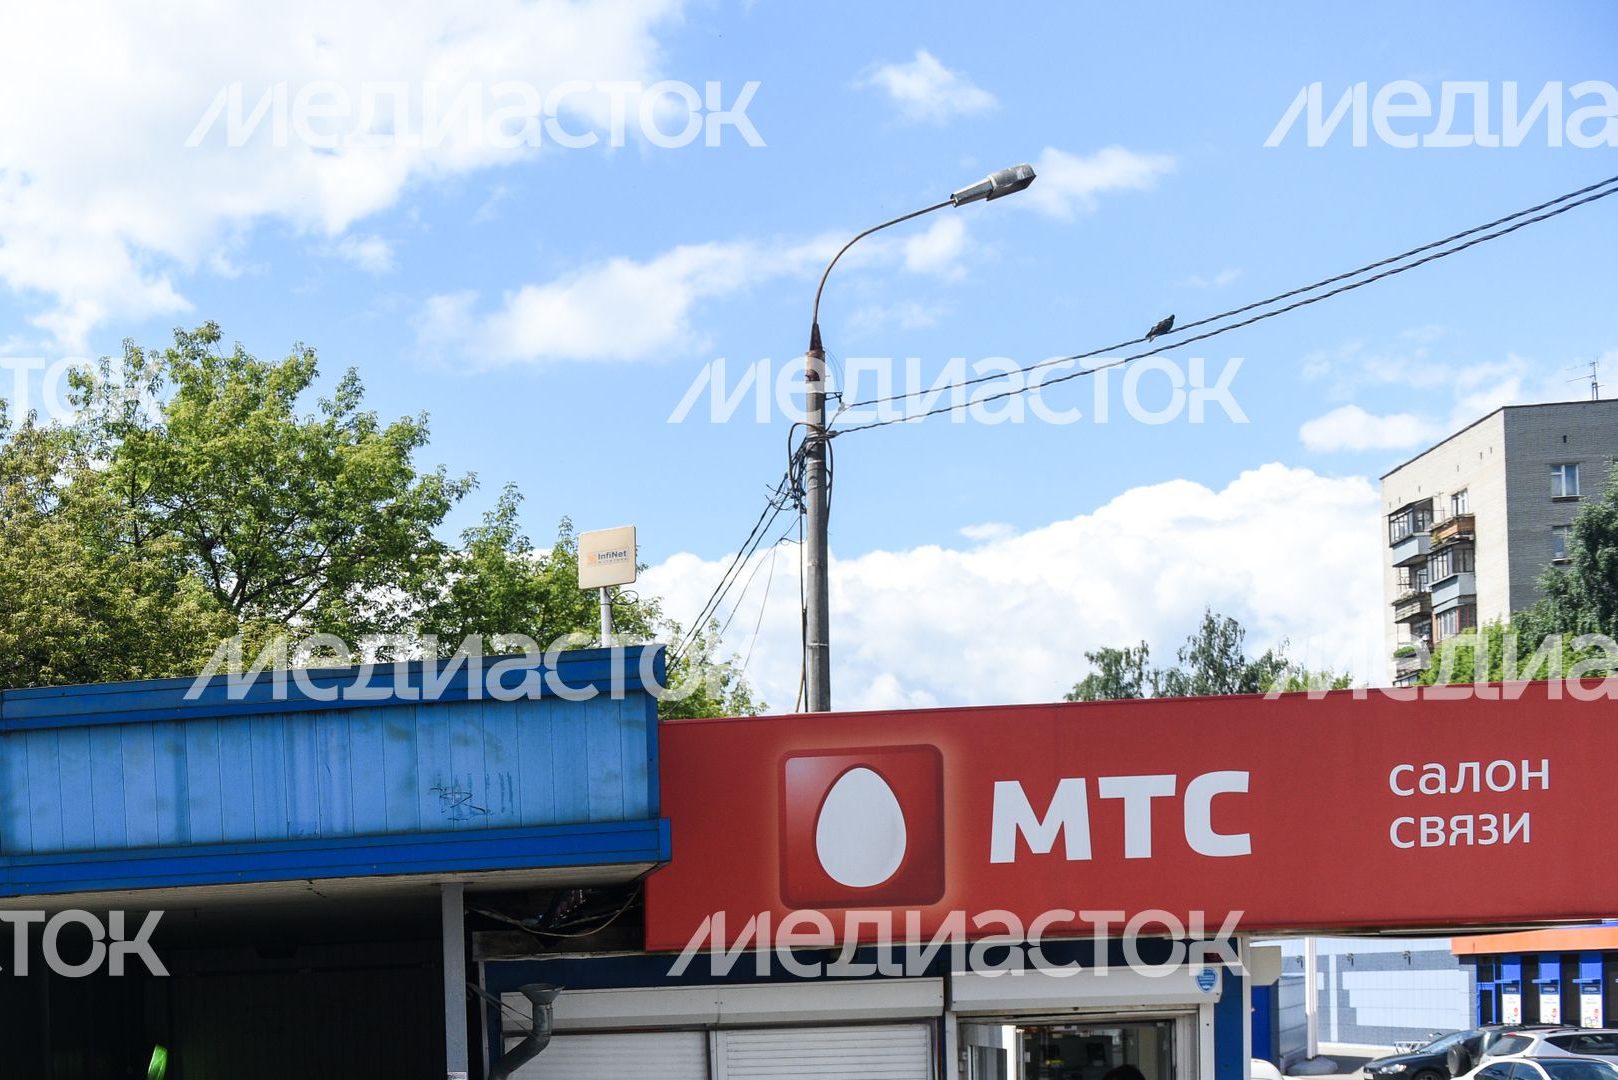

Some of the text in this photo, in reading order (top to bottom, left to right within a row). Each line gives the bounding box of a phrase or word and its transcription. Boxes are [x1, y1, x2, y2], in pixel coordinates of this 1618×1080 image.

[597, 550, 627, 560] InfiNet
[1389, 758, 1550, 797] салон
[989, 770, 1252, 864] МТС
[1389, 812, 1530, 849] связи
